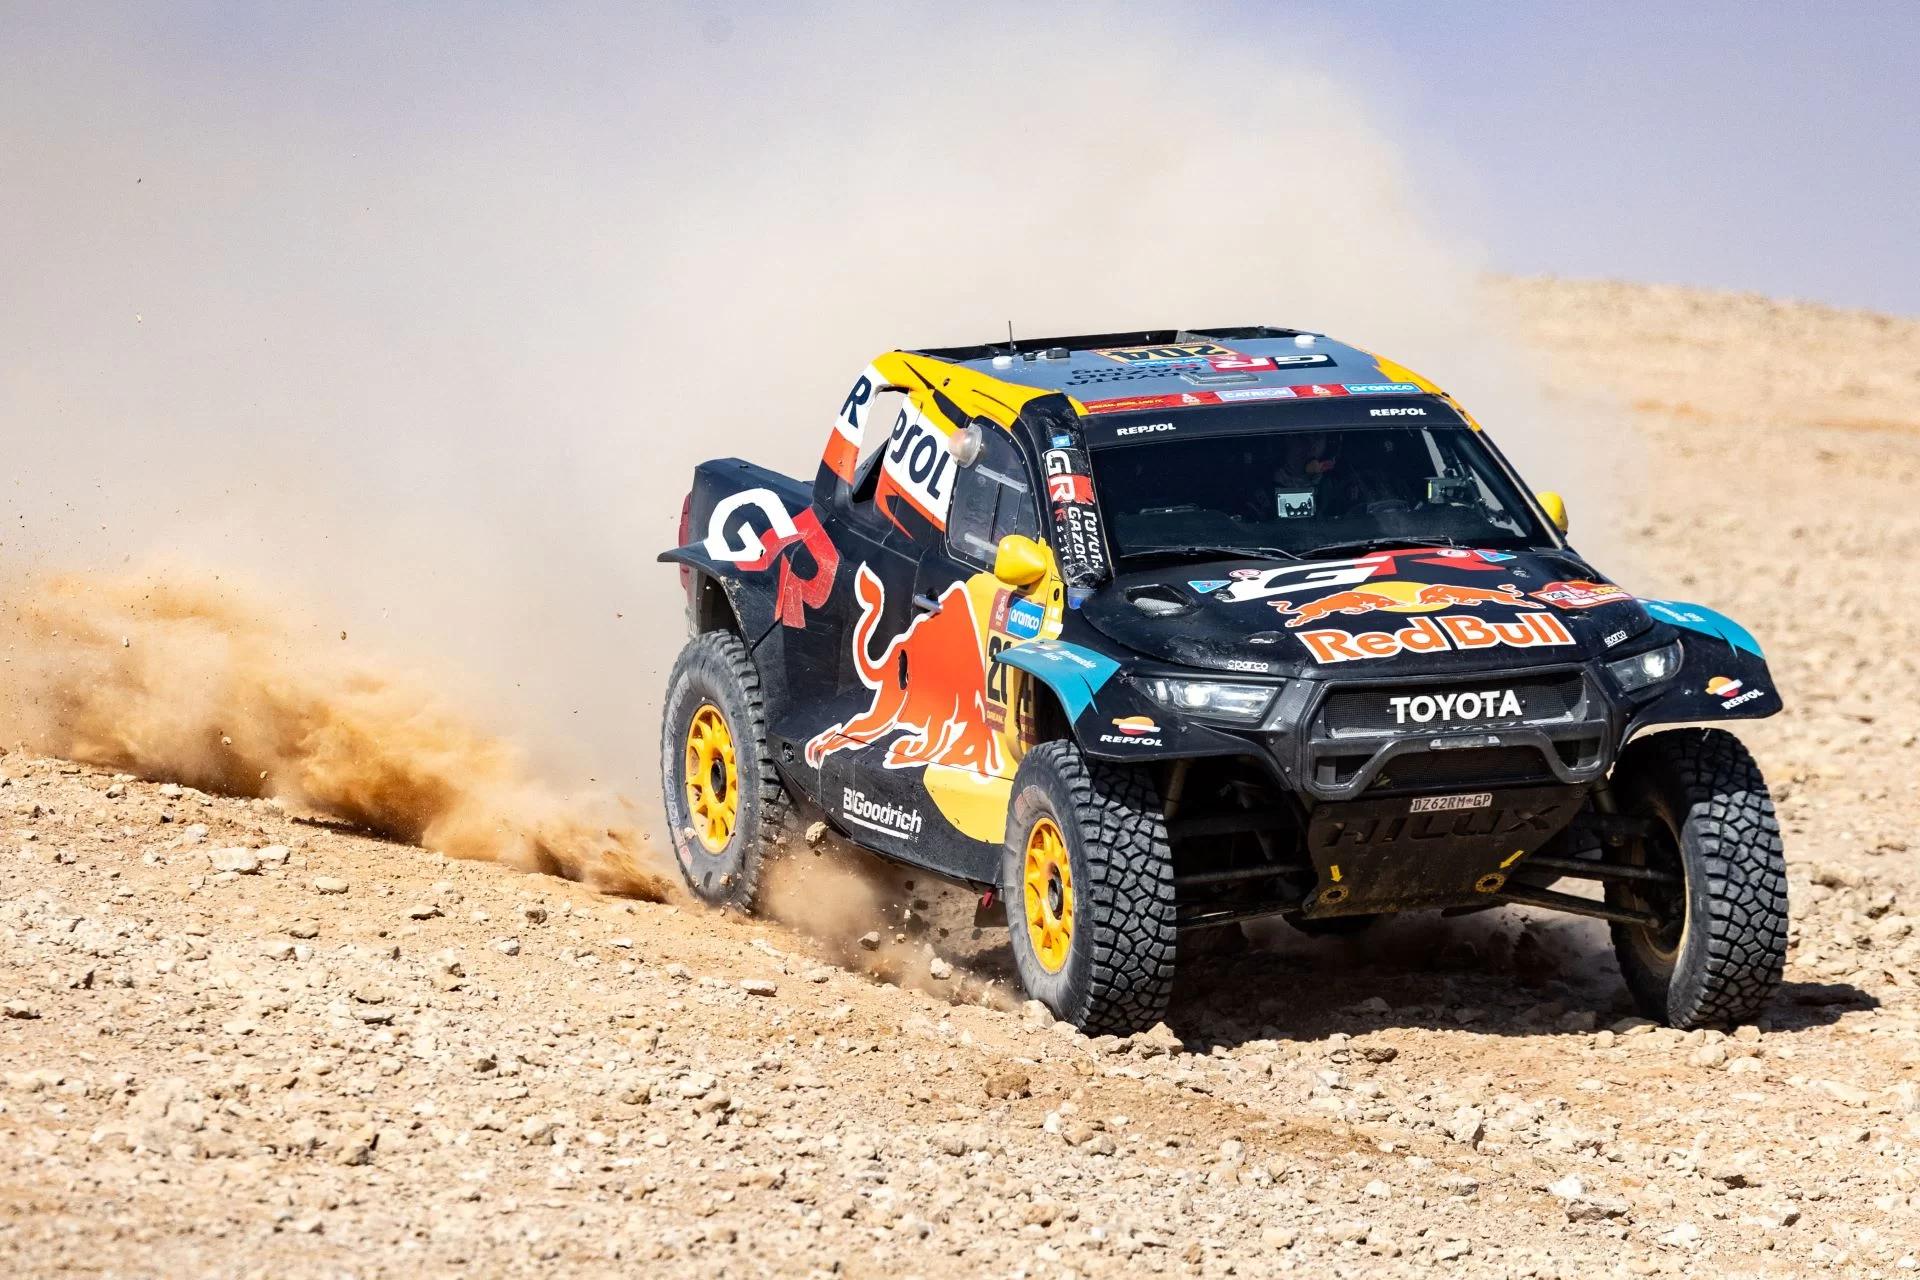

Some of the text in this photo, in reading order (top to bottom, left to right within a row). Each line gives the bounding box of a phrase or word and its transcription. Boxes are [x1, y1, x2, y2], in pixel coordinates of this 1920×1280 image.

[1349, 382, 1415, 392] aramco
[1369, 407, 1427, 417] REPSOL
[840, 374, 951, 500] RPSOL
[1116, 421, 1176, 436] REPSOL
[1045, 450, 1076, 503] GR
[703, 487, 840, 629] GR
[1010, 609, 1040, 630] aramco
[1294, 612, 1577, 665] Red Bull
[1604, 630, 1628, 647] sparco
[1227, 660, 1269, 672] sparco
[1390, 689, 1523, 723] TOYOTA
[1721, 688, 1765, 710] REPSOL
[1100, 733, 1163, 747] REPSOL
